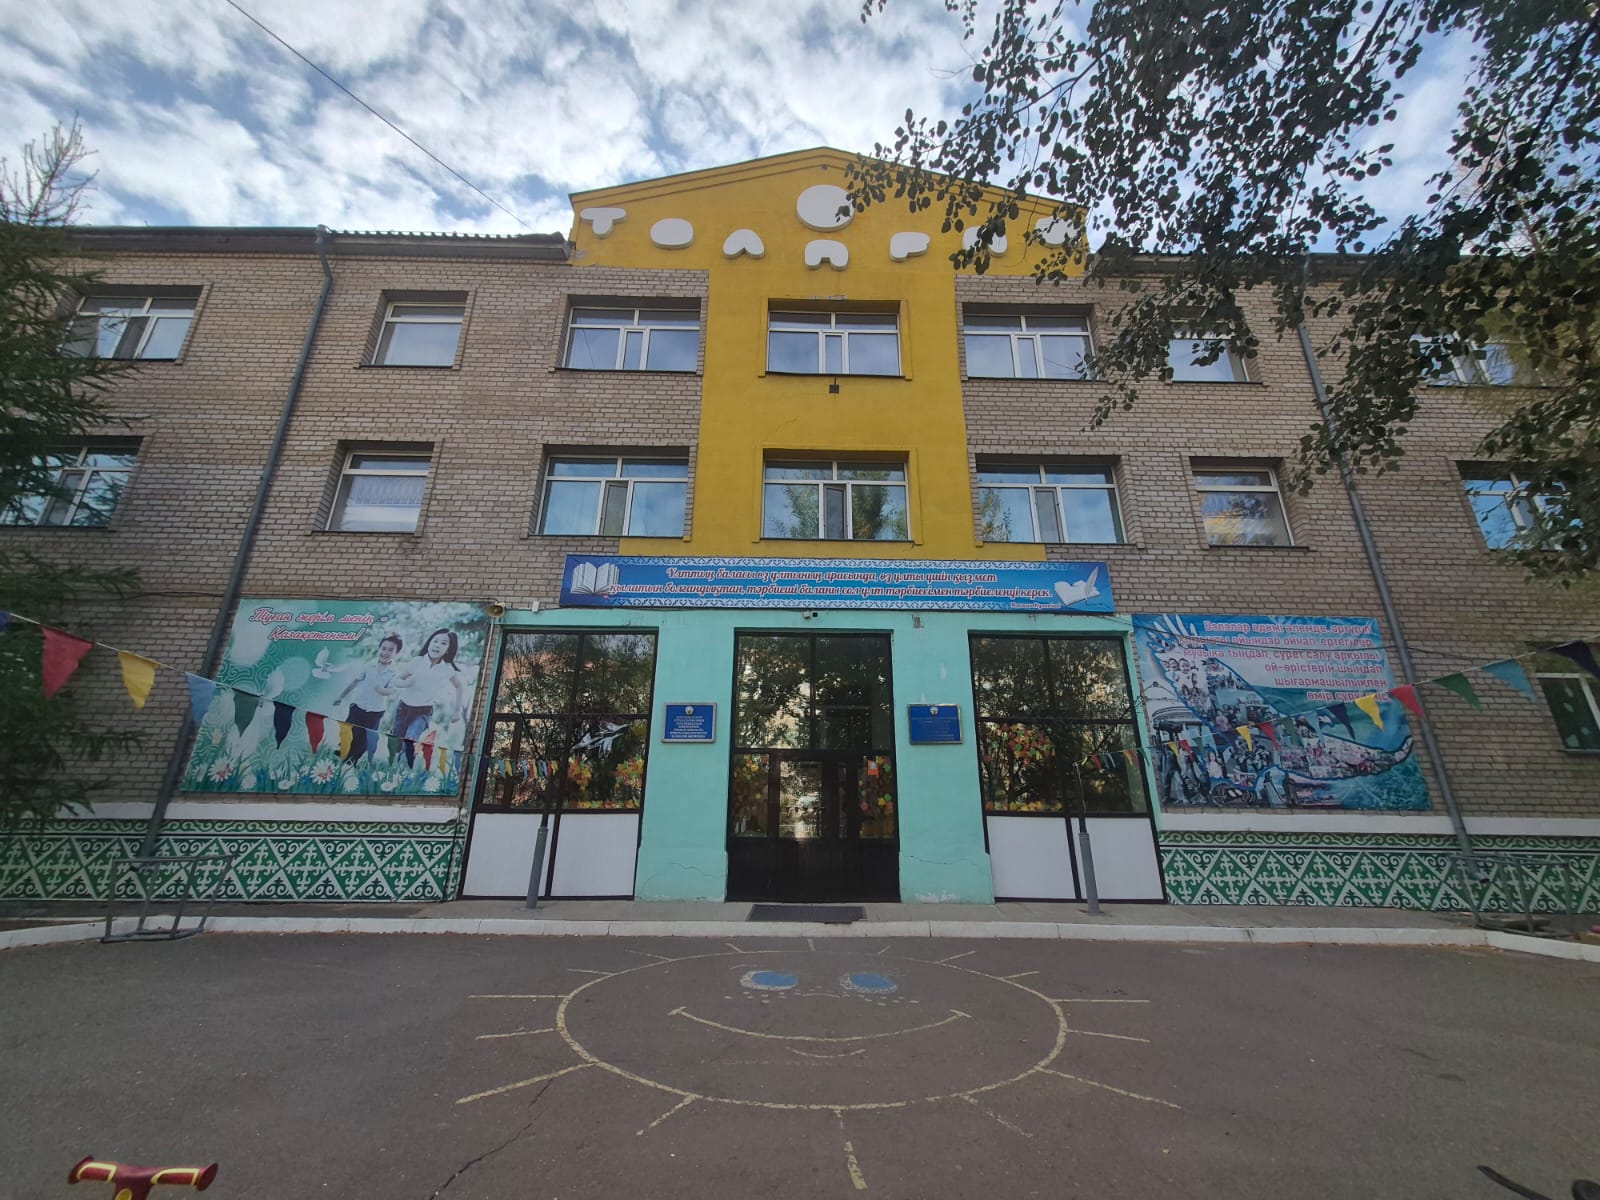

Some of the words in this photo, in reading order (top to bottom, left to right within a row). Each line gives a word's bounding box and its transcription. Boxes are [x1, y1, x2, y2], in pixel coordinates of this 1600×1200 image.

[717, 568, 755, 580] баласы
[952, 573, 998, 585] қызмет
[799, 584, 840, 595] баланы
[841, 586, 859, 596] сол
[860, 586, 884, 598] ұлт
